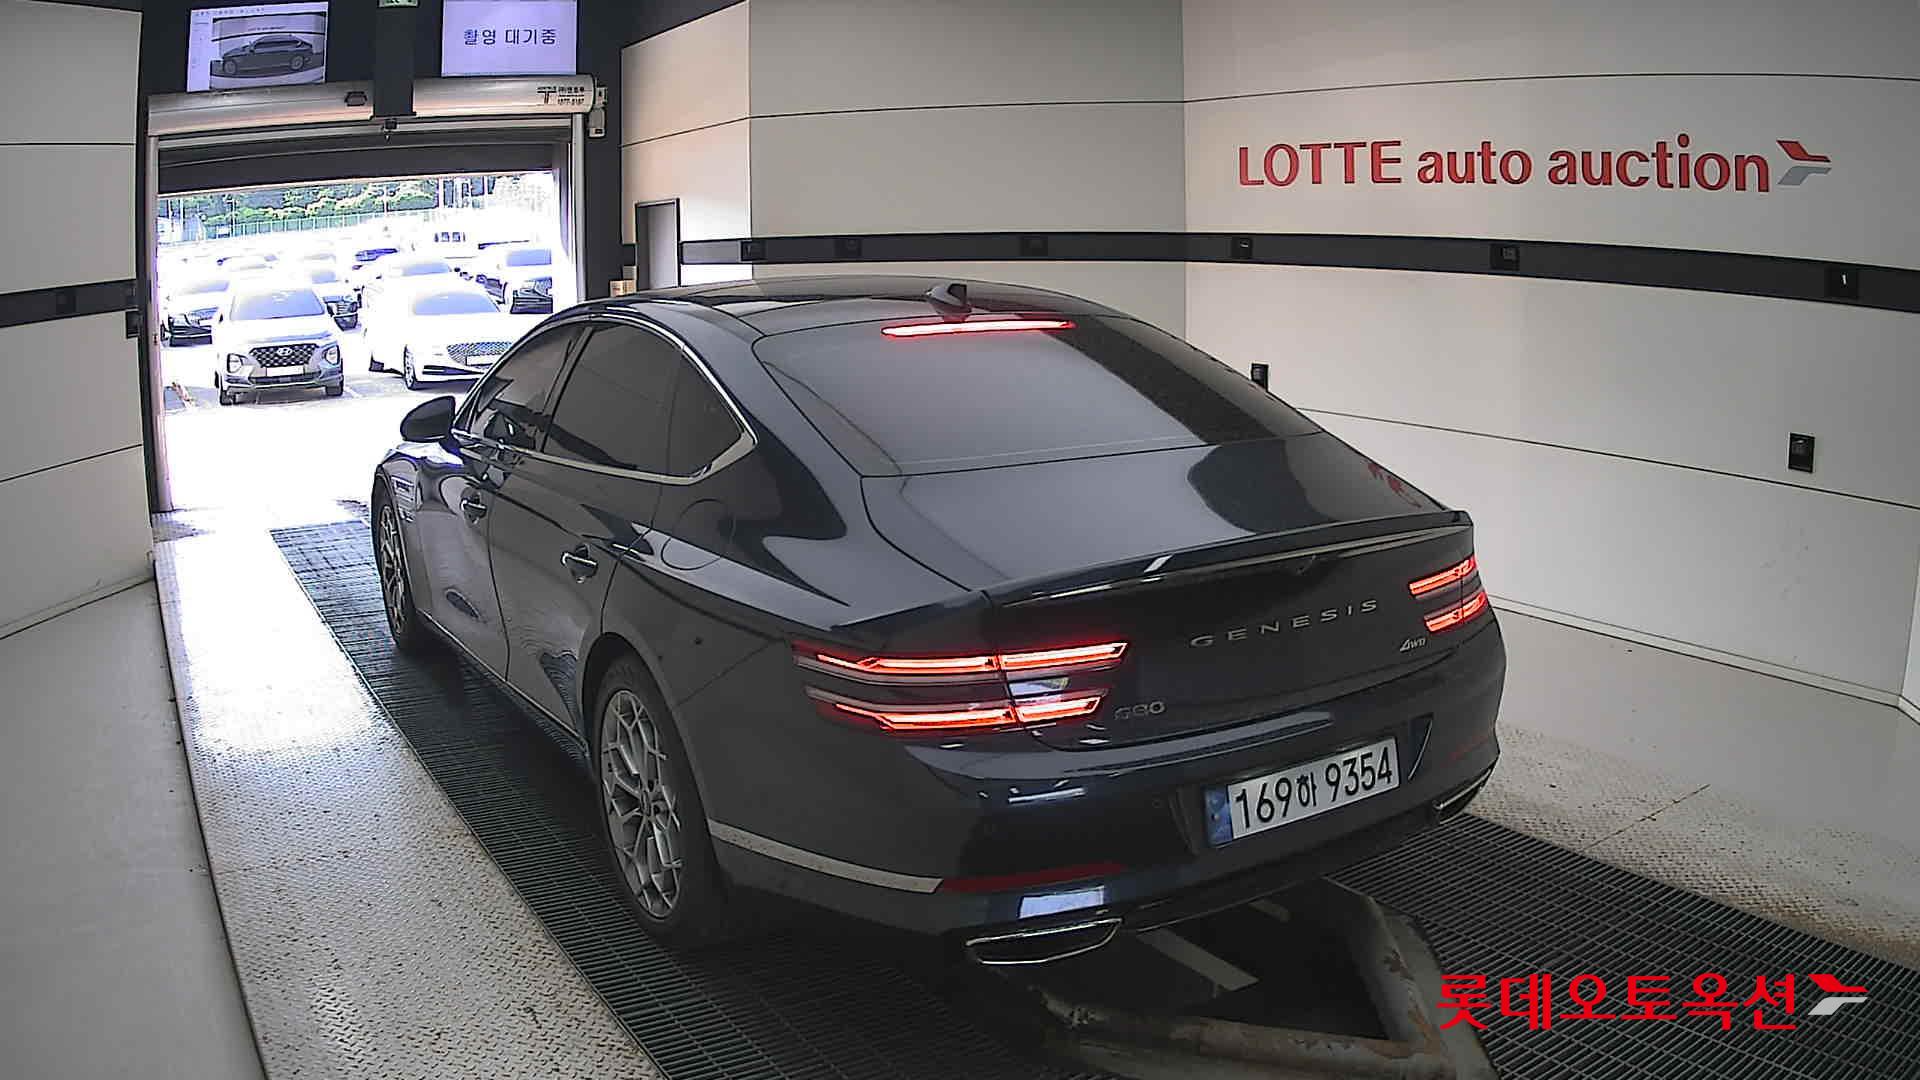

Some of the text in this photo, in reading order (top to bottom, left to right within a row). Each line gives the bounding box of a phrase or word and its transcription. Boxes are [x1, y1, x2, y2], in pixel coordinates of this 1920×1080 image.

[504, 28, 556, 46] 대기중
[1238, 133, 1771, 193] LOTTE auto auction
[1189, 599, 1378, 647] GENESIS
[1235, 746, 1393, 829] 169하 9354
